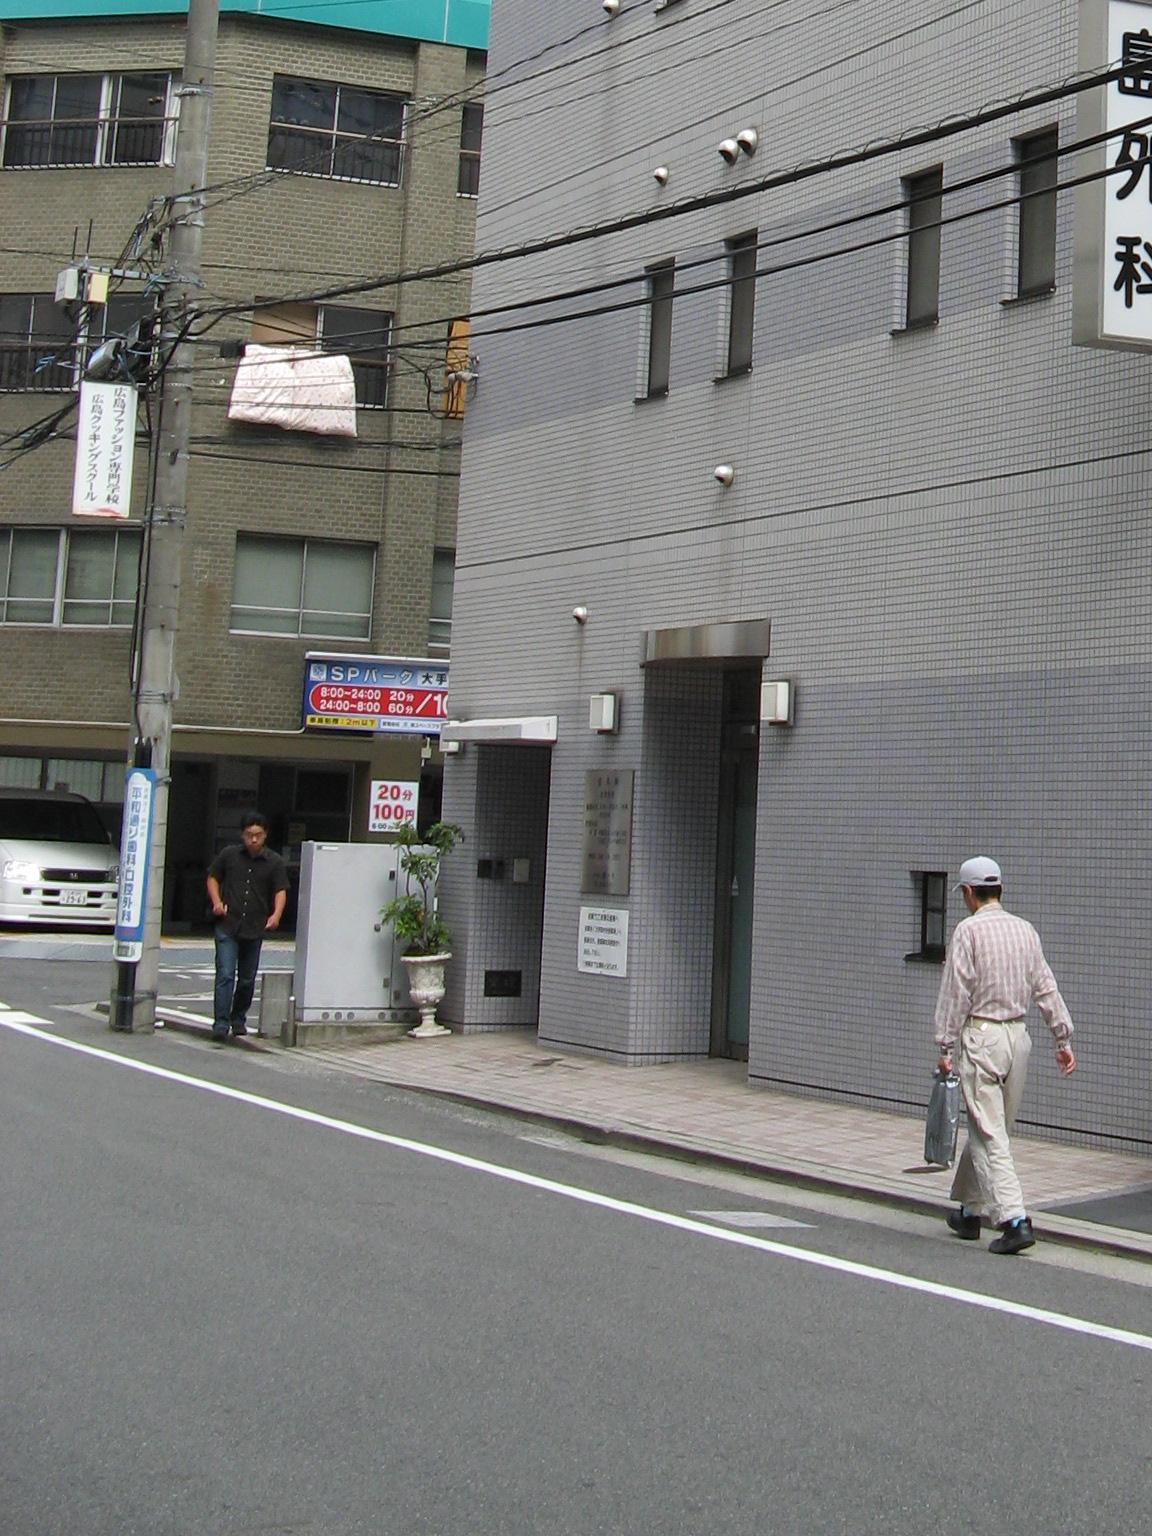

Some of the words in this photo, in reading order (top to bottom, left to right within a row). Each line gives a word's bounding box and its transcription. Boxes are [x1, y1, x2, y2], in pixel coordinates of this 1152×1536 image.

[84, 394, 104, 502] 広島クッキングスクール
[104, 386, 127, 505] 広島ファッション専門学校
[330, 666, 413, 685] SPパーク
[389, 690, 415, 702] 20分
[388, 703, 414, 715] 60分
[377, 784, 414, 801] 20分
[373, 804, 415, 821] 100円
